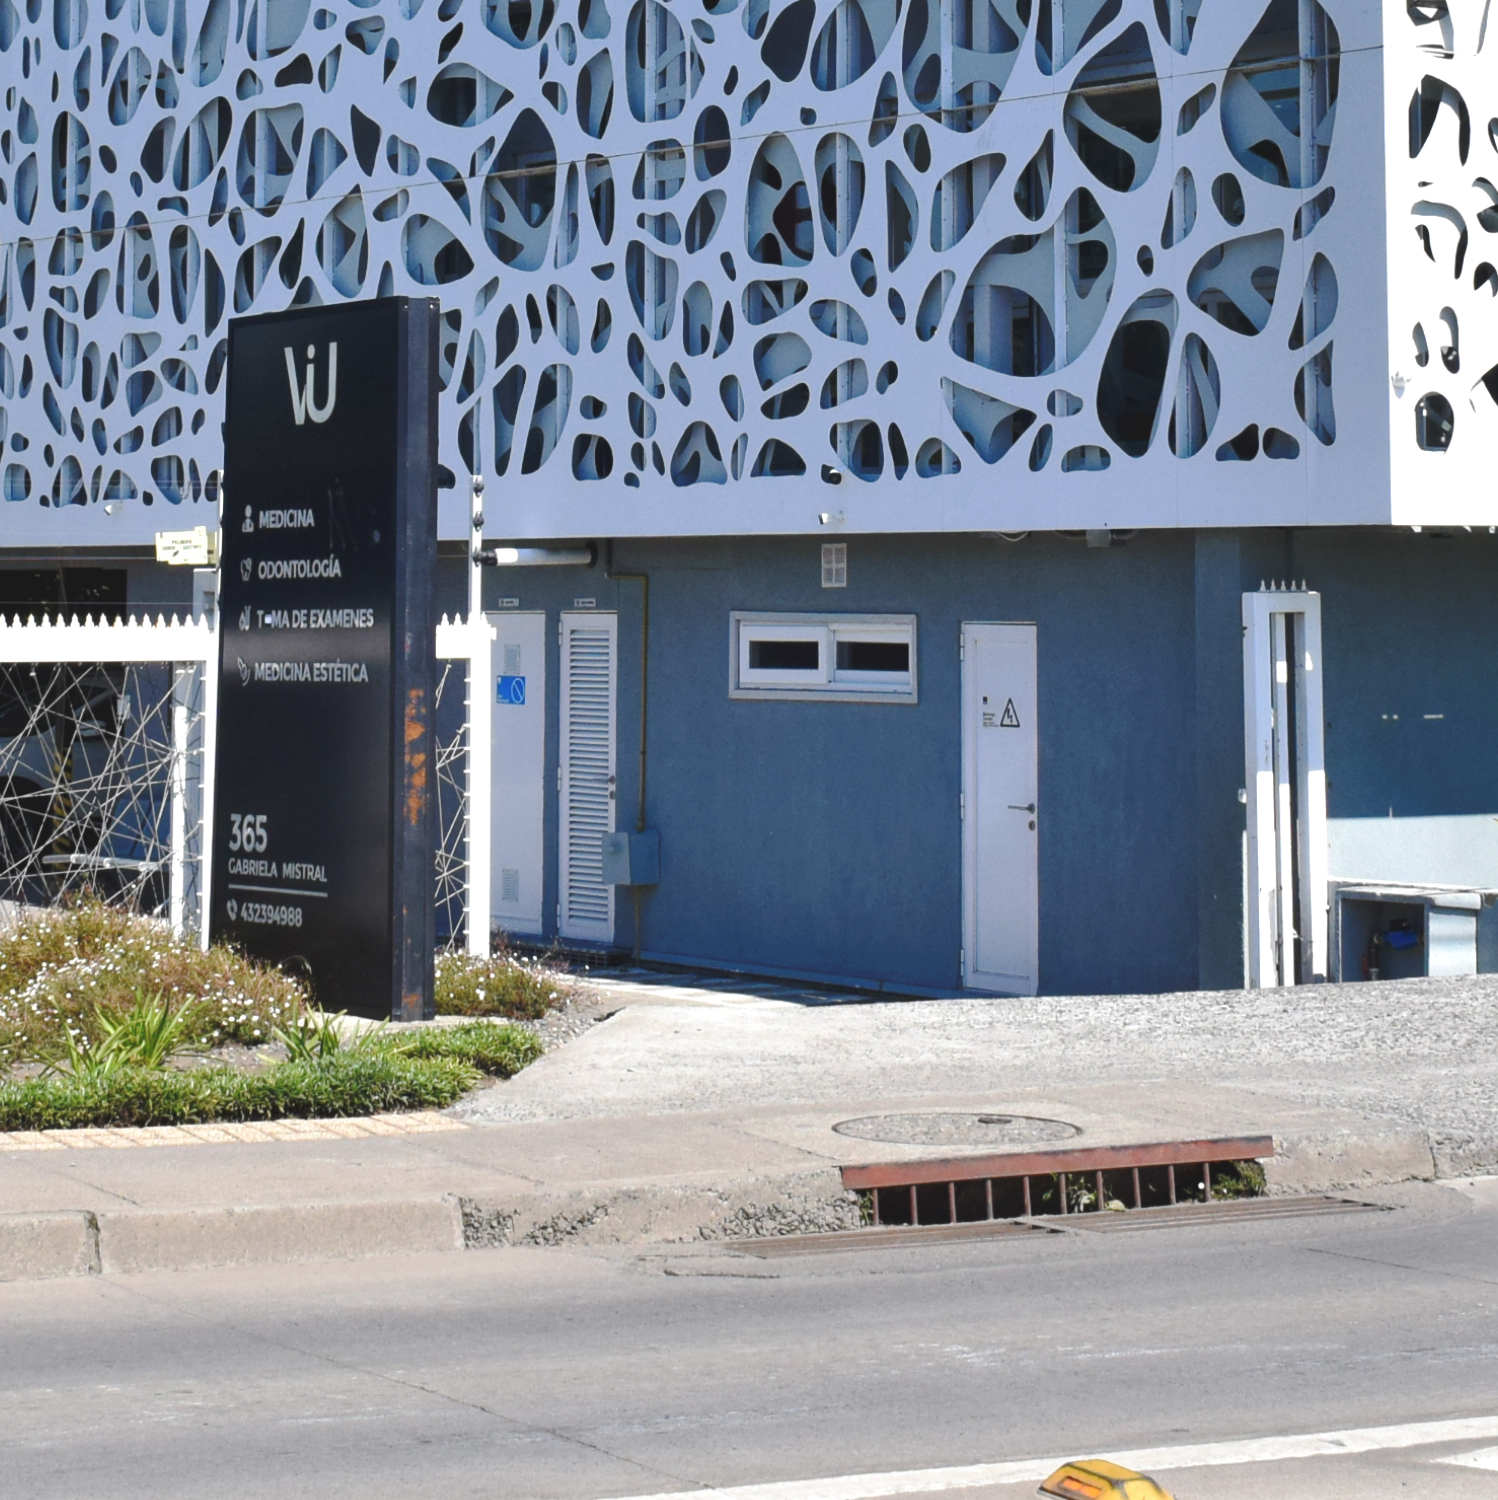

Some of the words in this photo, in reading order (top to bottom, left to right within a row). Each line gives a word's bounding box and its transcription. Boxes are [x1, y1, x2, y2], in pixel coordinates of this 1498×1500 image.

[258, 508, 315, 529] MEDICINA
[258, 553, 342, 580] ODONTOLOGÍA
[256, 609, 290, 629] TMA
[291, 609, 308, 629] DE
[309, 608, 374, 629] EXAMENES
[254, 662, 311, 682] MEDICINA
[313, 657, 369, 682] ESTÉTICA
[229, 813, 268, 853] 365
[228, 857, 278, 878] GABRIELA
[282, 862, 328, 882] MISTRAL
[241, 902, 303, 927] 432394988
